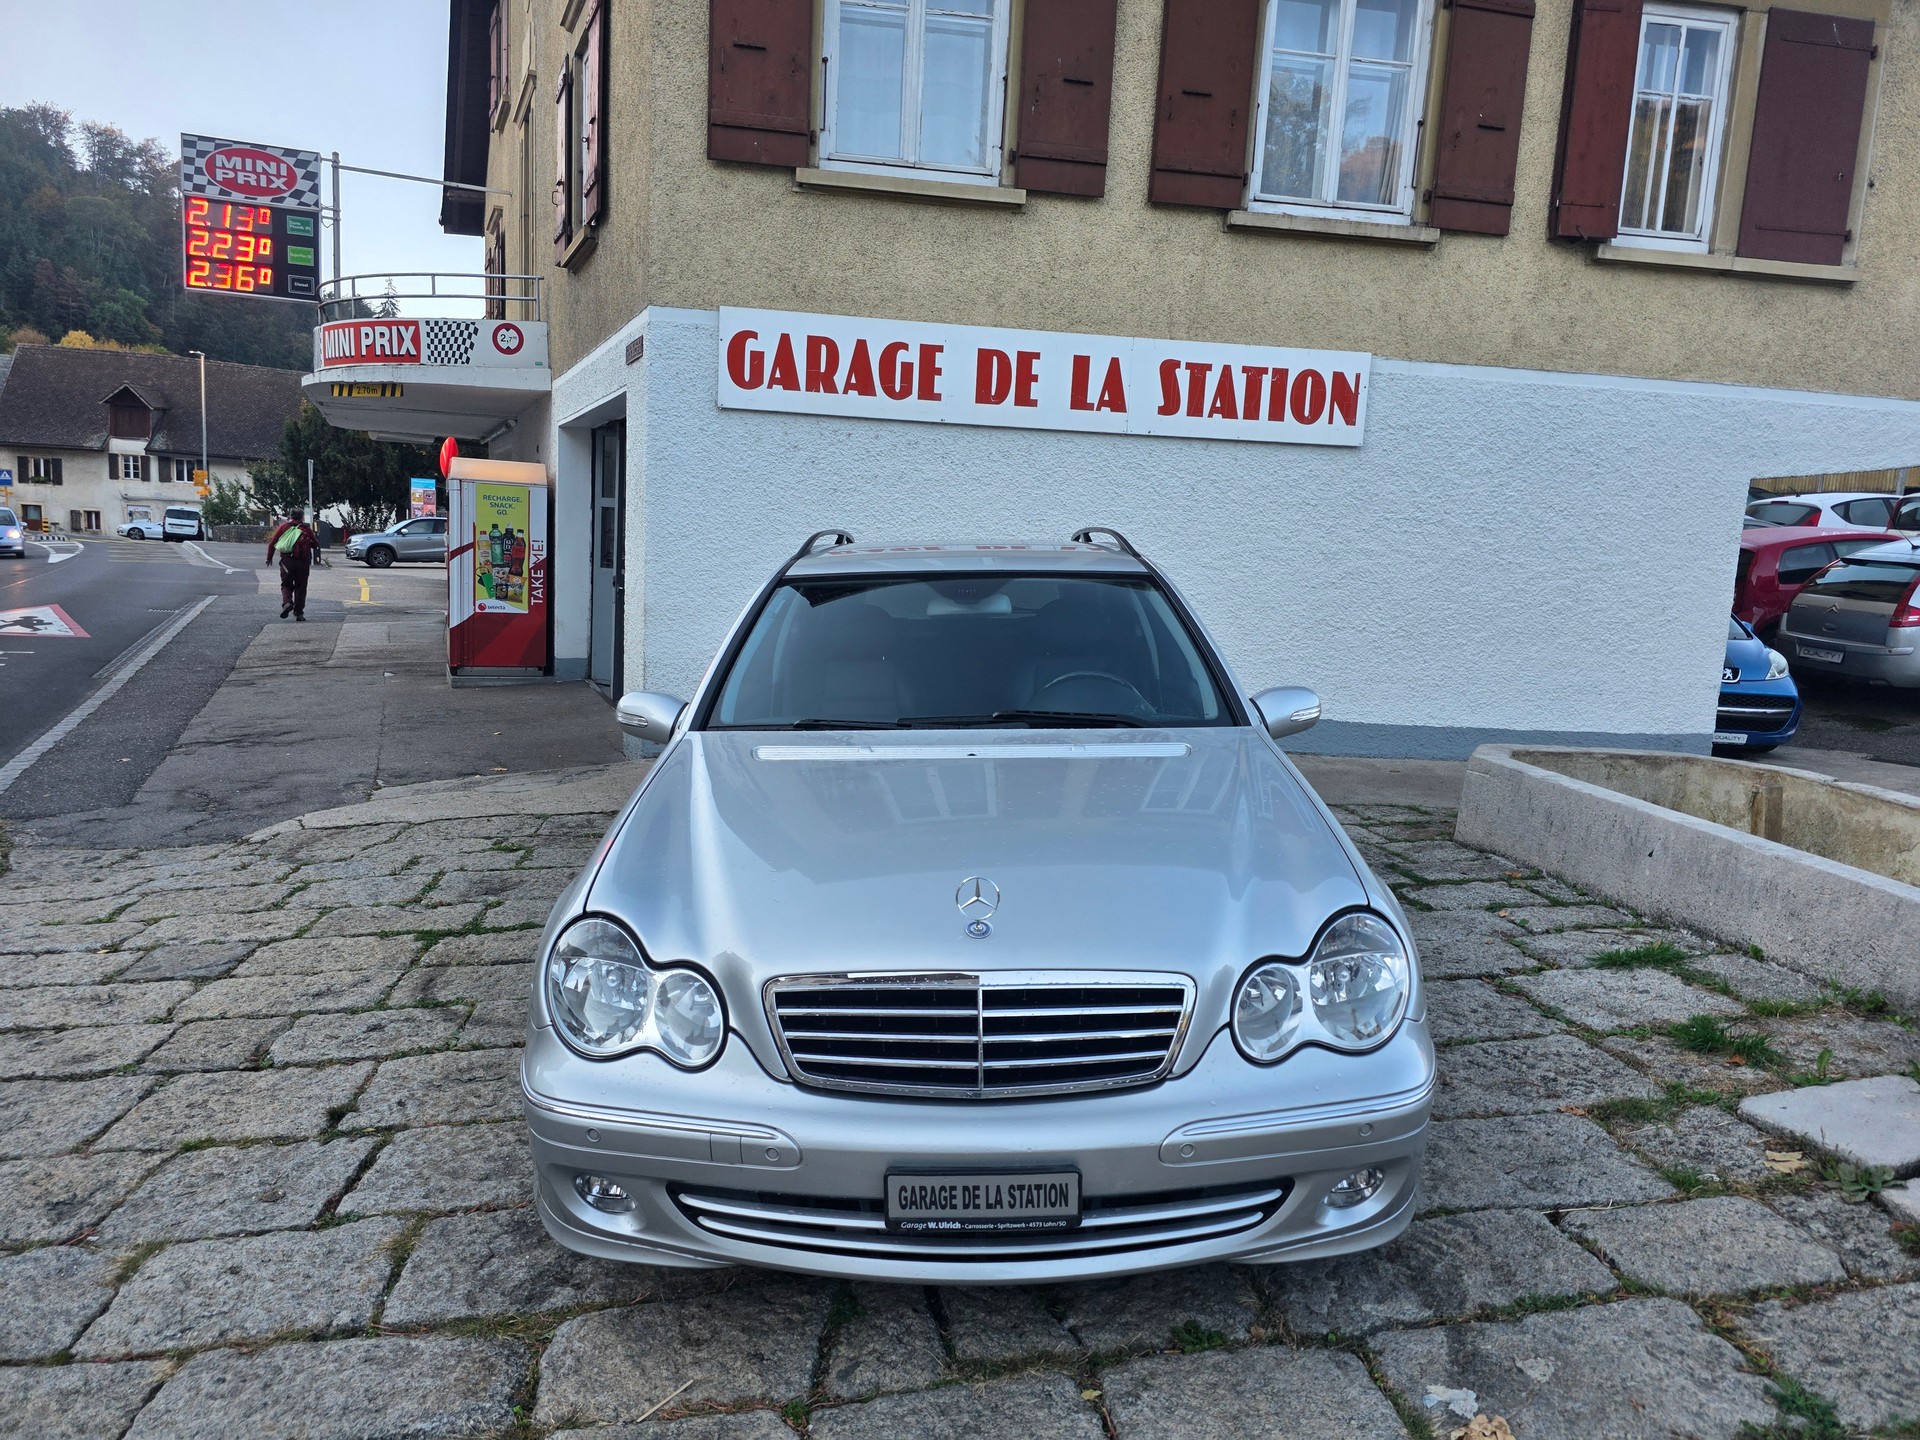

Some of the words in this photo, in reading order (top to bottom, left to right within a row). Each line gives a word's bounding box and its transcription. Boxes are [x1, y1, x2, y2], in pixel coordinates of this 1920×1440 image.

[215, 154, 288, 176] MINI
[215, 169, 289, 190] PRIX
[325, 327, 355, 359] MINI
[361, 325, 417, 356] PRIX
[727, 330, 943, 400] GARAGE
[975, 349, 1040, 407] DE
[1070, 355, 1126, 412] LA
[1157, 359, 1360, 425] STATION
[483, 494, 523, 503] RECHARGE.
[531, 539, 544, 566] ME!
[531, 569, 544, 606] TAKE
[898, 1184, 958, 1211] GARAGE
[962, 1185, 981, 1210] DE
[985, 1184, 1004, 1210] LA
[1007, 1182, 1069, 1210] STATION
[901, 1221, 927, 1231] Garage
[997, 1222, 1026, 1230] Spritzwerk
